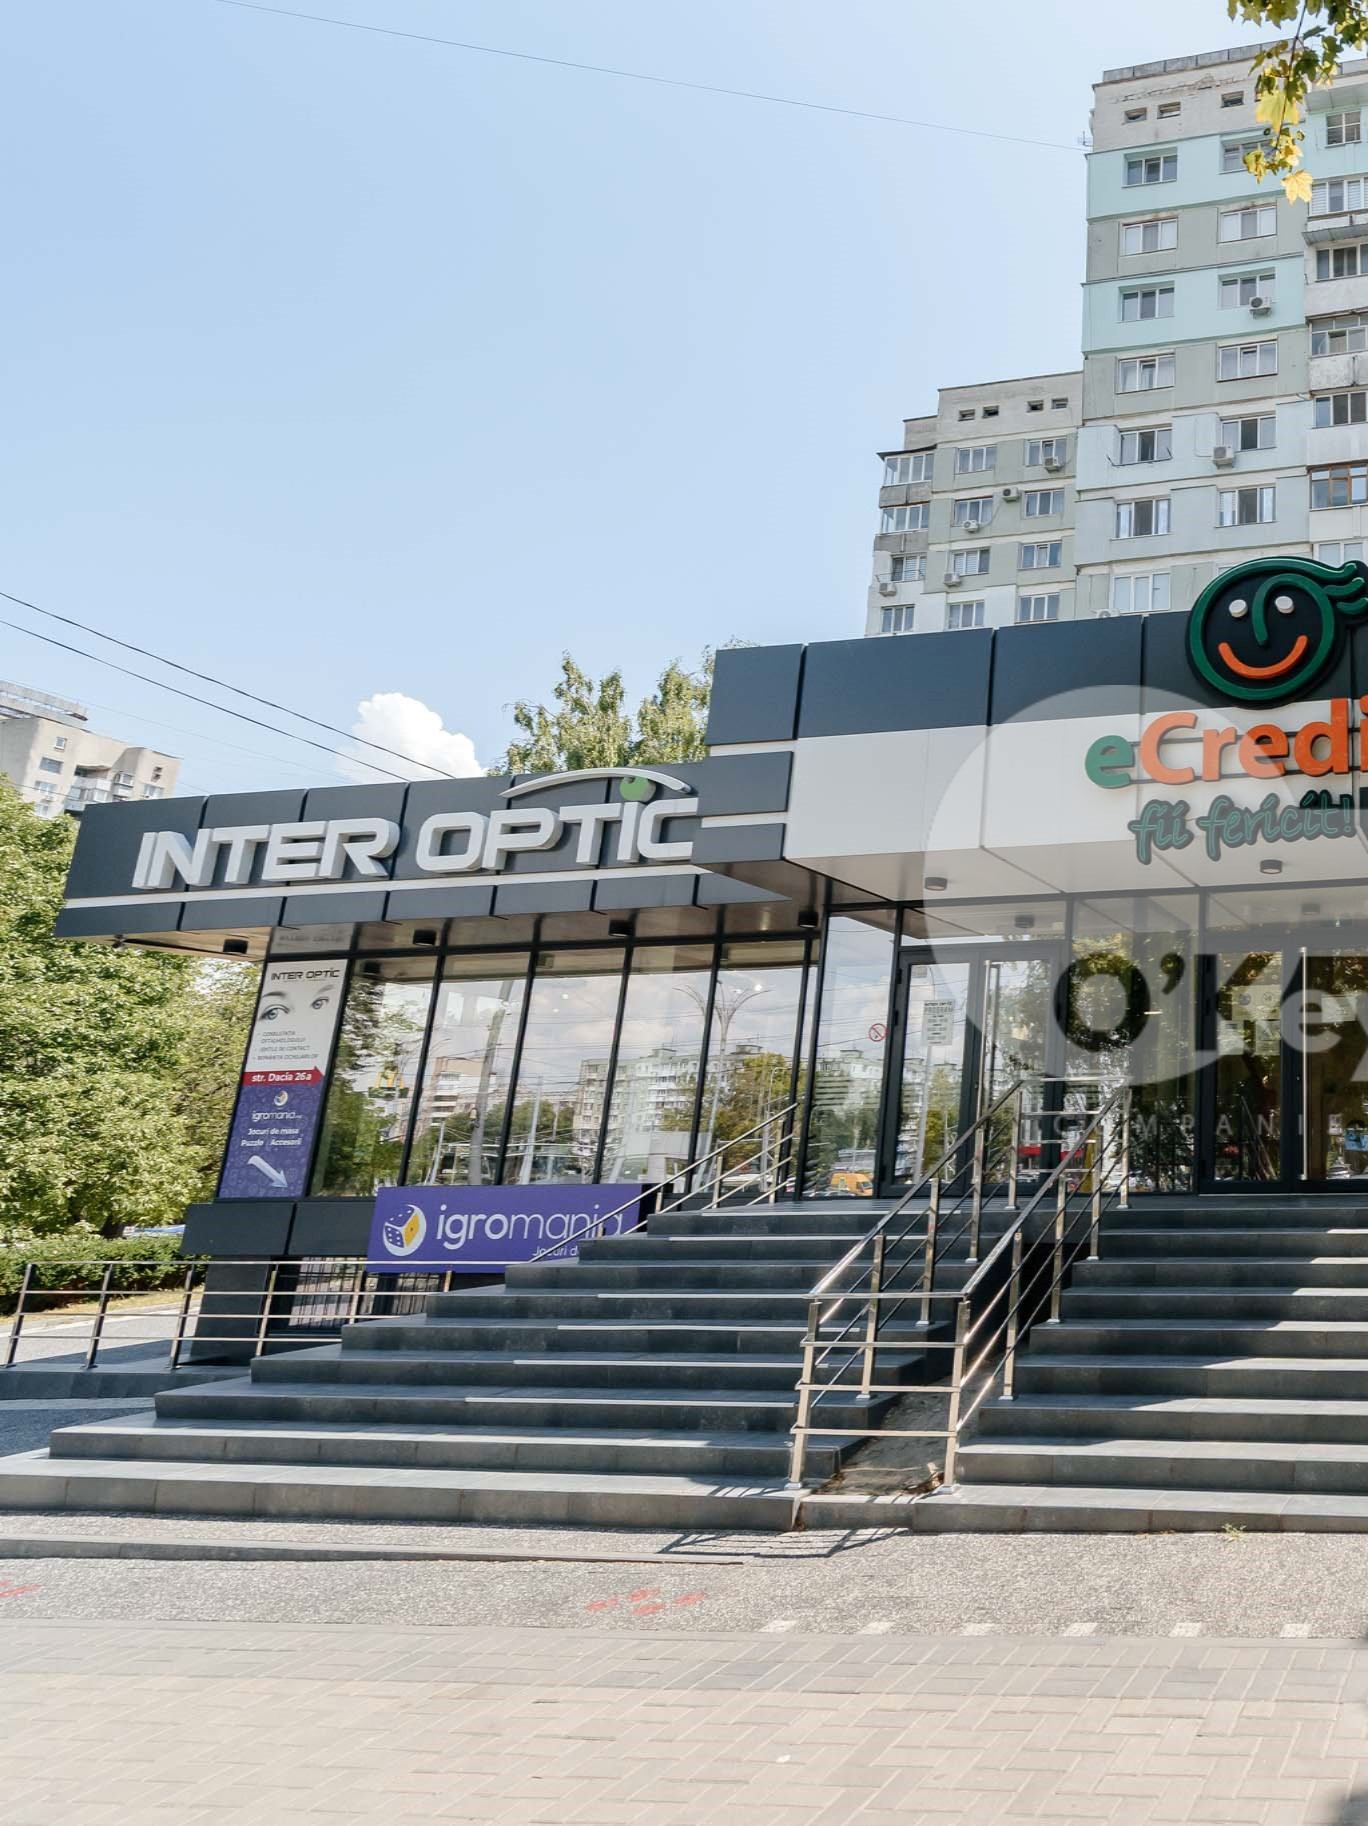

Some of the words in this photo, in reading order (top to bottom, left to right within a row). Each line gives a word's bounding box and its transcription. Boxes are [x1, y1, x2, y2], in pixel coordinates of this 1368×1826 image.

[132, 817, 399, 889] INTER
[416, 776, 699, 872] OPTIC
[1129, 800, 1193, 862] fii
[1199, 791, 1354, 860] fericit!
[271, 971, 303, 981] INTER
[305, 968, 341, 979] OPTIC
[252, 1074, 266, 1082] str.
[268, 1073, 293, 1082] Dacia
[269, 1127, 280, 1135] de
[436, 1204, 623, 1250] igromania
